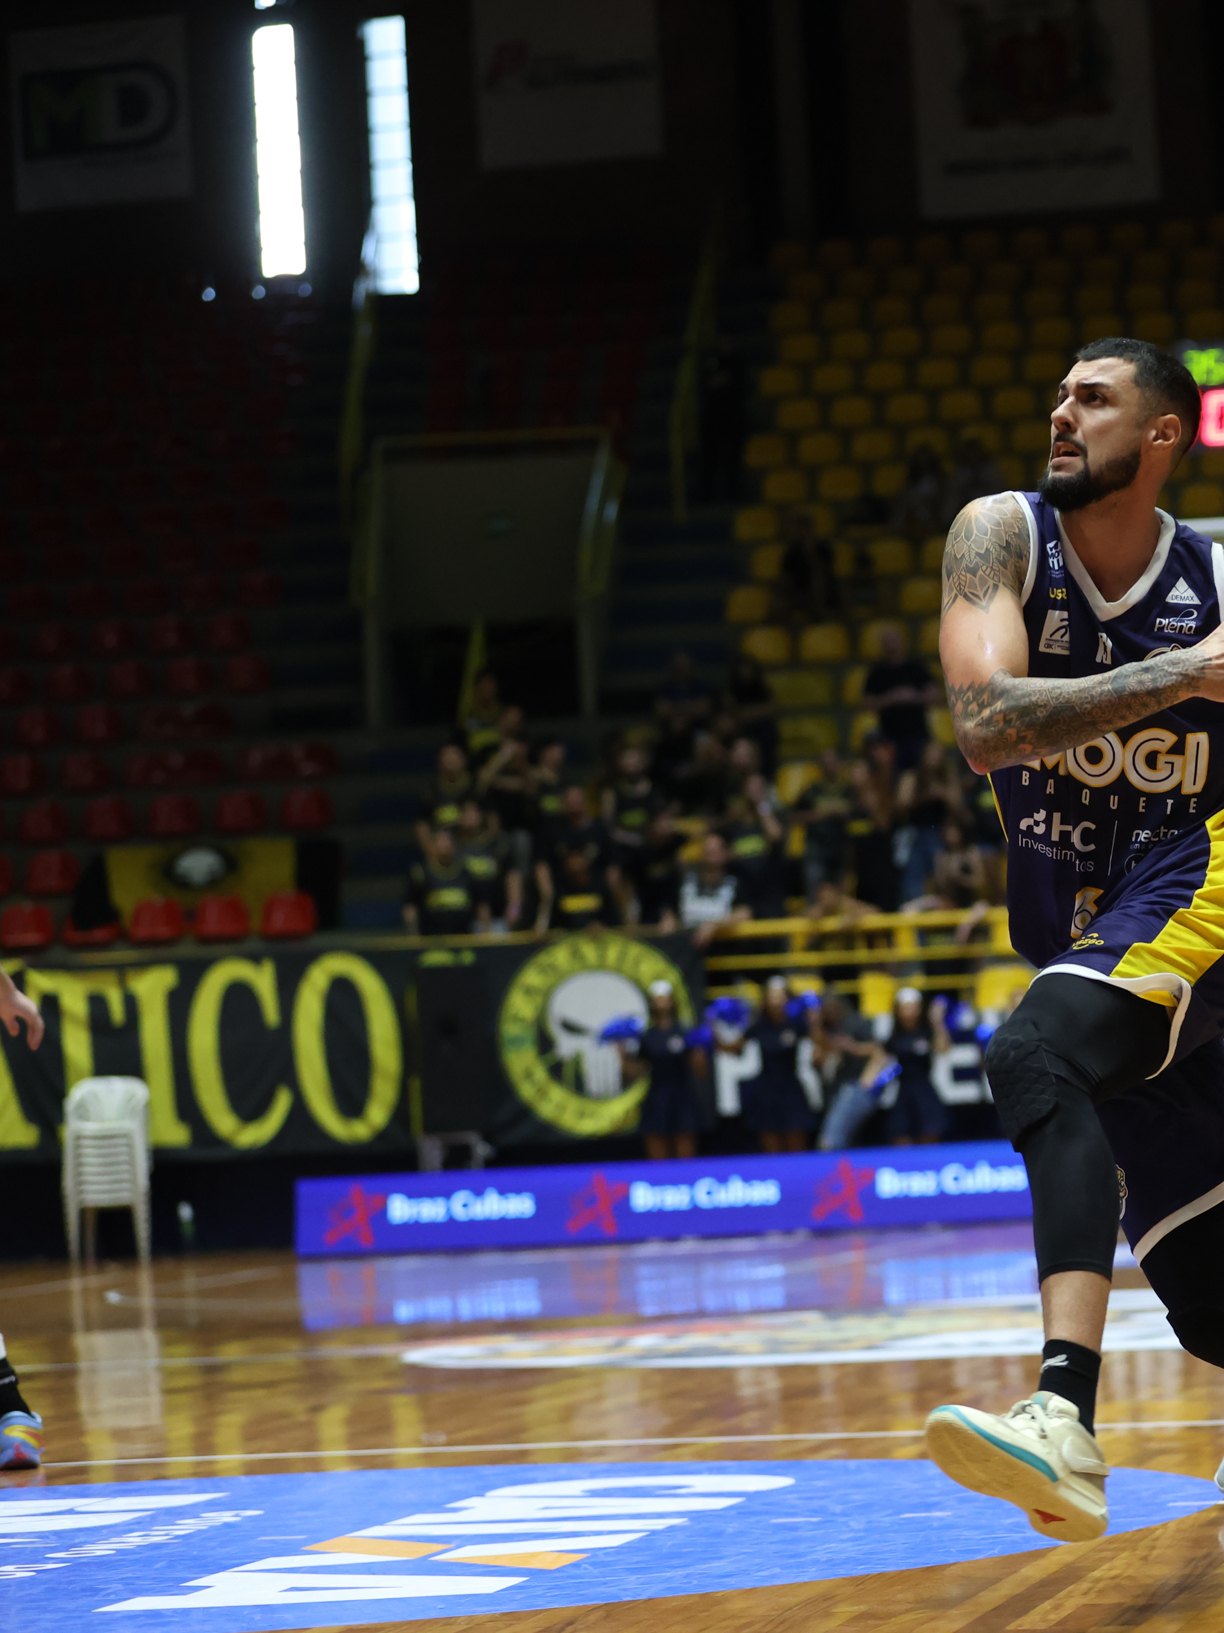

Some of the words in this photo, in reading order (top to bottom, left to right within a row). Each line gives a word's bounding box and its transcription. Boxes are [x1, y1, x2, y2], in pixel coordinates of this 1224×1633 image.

[1171, 594, 1195, 602] DEMAX
[1154, 617, 1196, 634] Plena
[1021, 770, 1198, 814] BAQUETE
[1051, 812, 1096, 852] HC
[629, 1181, 693, 1213] Braz
[694, 1174, 781, 1209] Cubas
[875, 1166, 939, 1199] Braz
[940, 1160, 1028, 1195] Cubas
[387, 1193, 448, 1225] Braz
[450, 1187, 536, 1221] Cubas
[44, 1510, 264, 1557] GOVERNO
[92, 1474, 796, 1612] CAIXA
